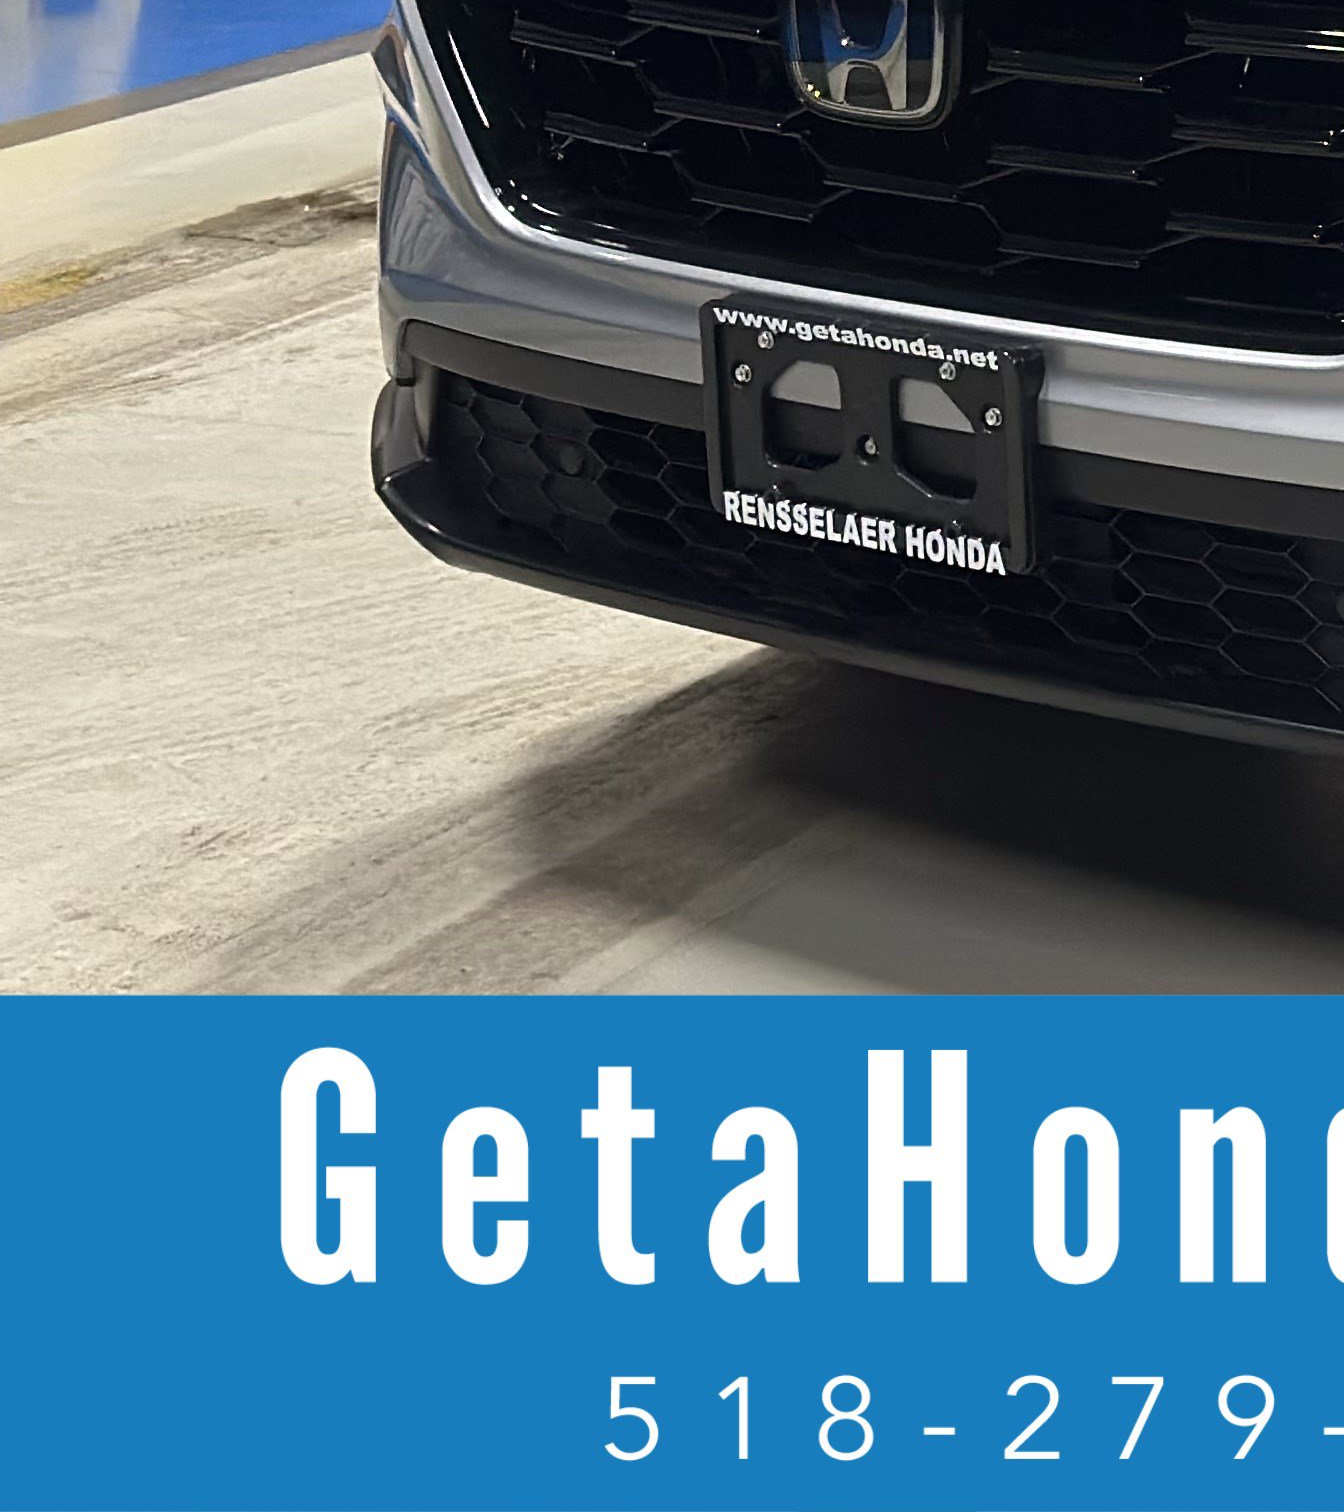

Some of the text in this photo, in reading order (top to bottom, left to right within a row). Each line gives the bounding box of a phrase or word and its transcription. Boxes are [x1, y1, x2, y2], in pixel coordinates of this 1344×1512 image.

[712, 306, 999, 370] www.getahonda.net
[723, 490, 1007, 576] RENSSELAER HONDA
